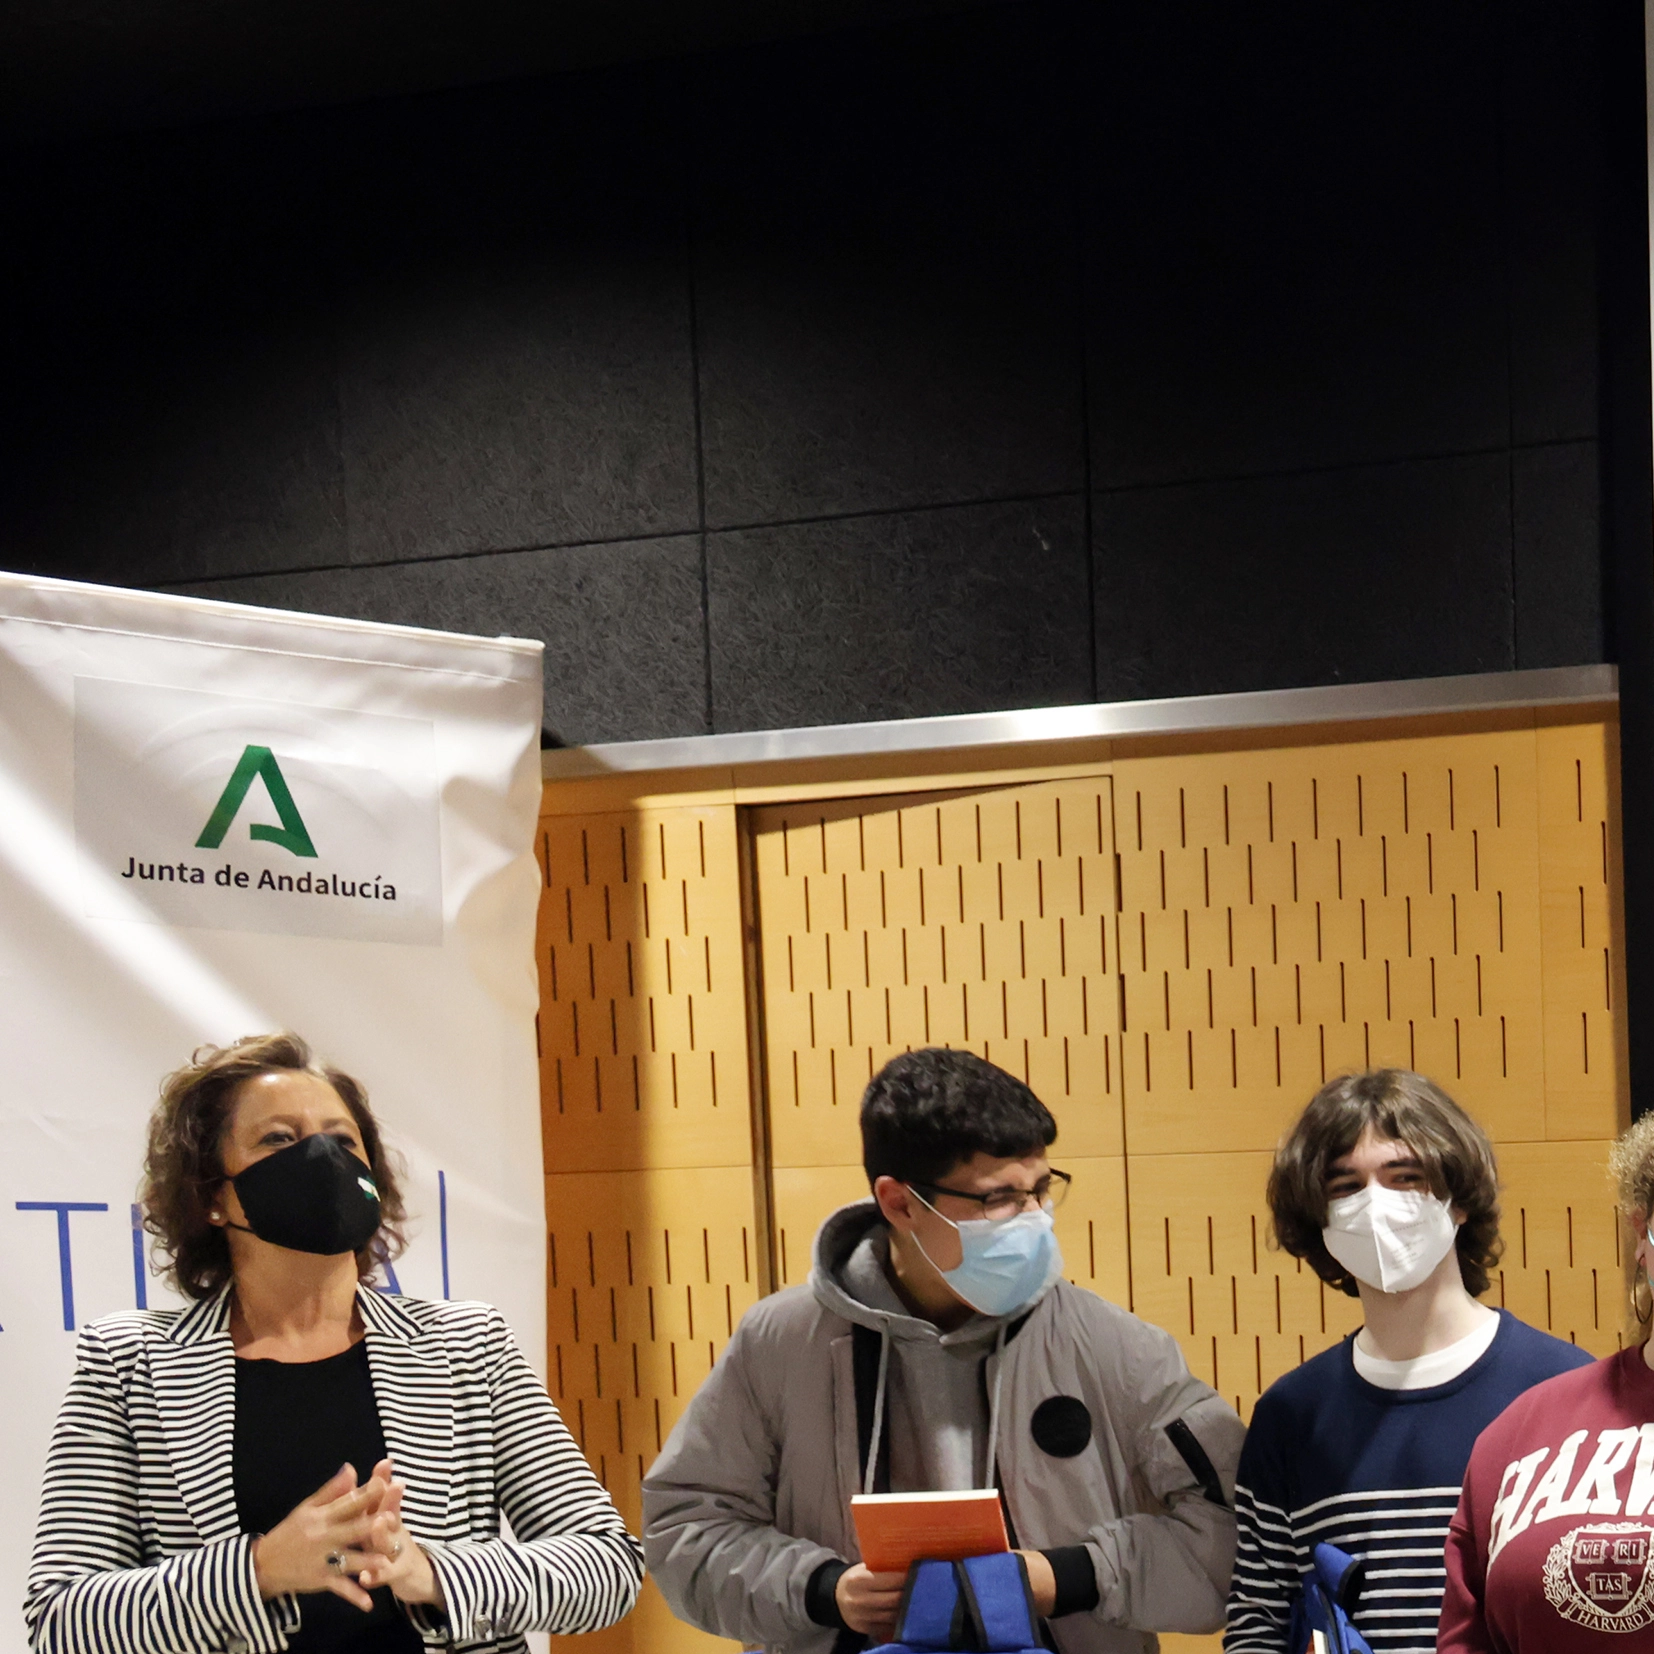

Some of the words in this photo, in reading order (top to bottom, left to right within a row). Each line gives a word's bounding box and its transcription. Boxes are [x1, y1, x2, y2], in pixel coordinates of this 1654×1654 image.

[121, 857, 205, 884] Junta
[214, 864, 250, 888] de
[257, 869, 397, 901] Andalucía
[1578, 1611, 1643, 1631] HARVARD
